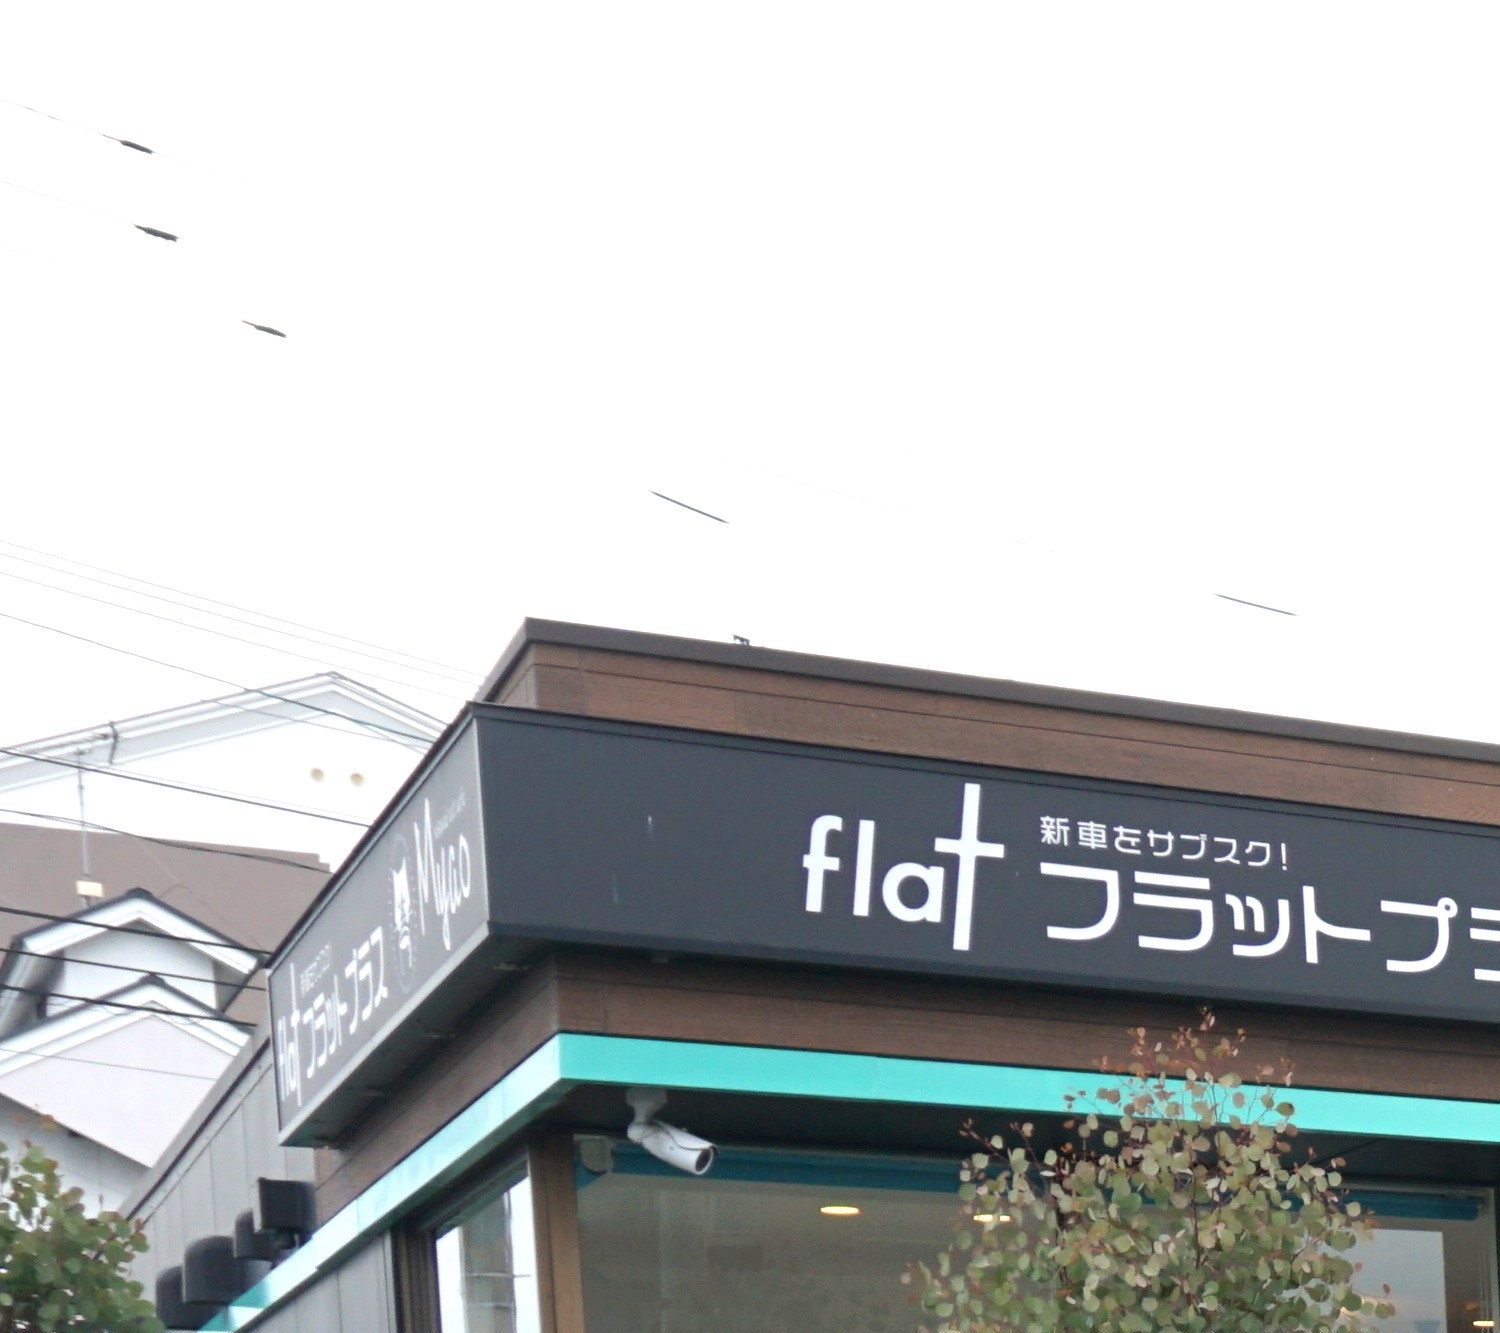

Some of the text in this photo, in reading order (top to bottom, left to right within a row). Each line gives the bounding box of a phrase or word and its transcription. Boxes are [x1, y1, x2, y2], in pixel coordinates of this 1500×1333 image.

[803, 783, 1005, 951] flat
[1039, 815, 1288, 872] 新車をサブスク!
